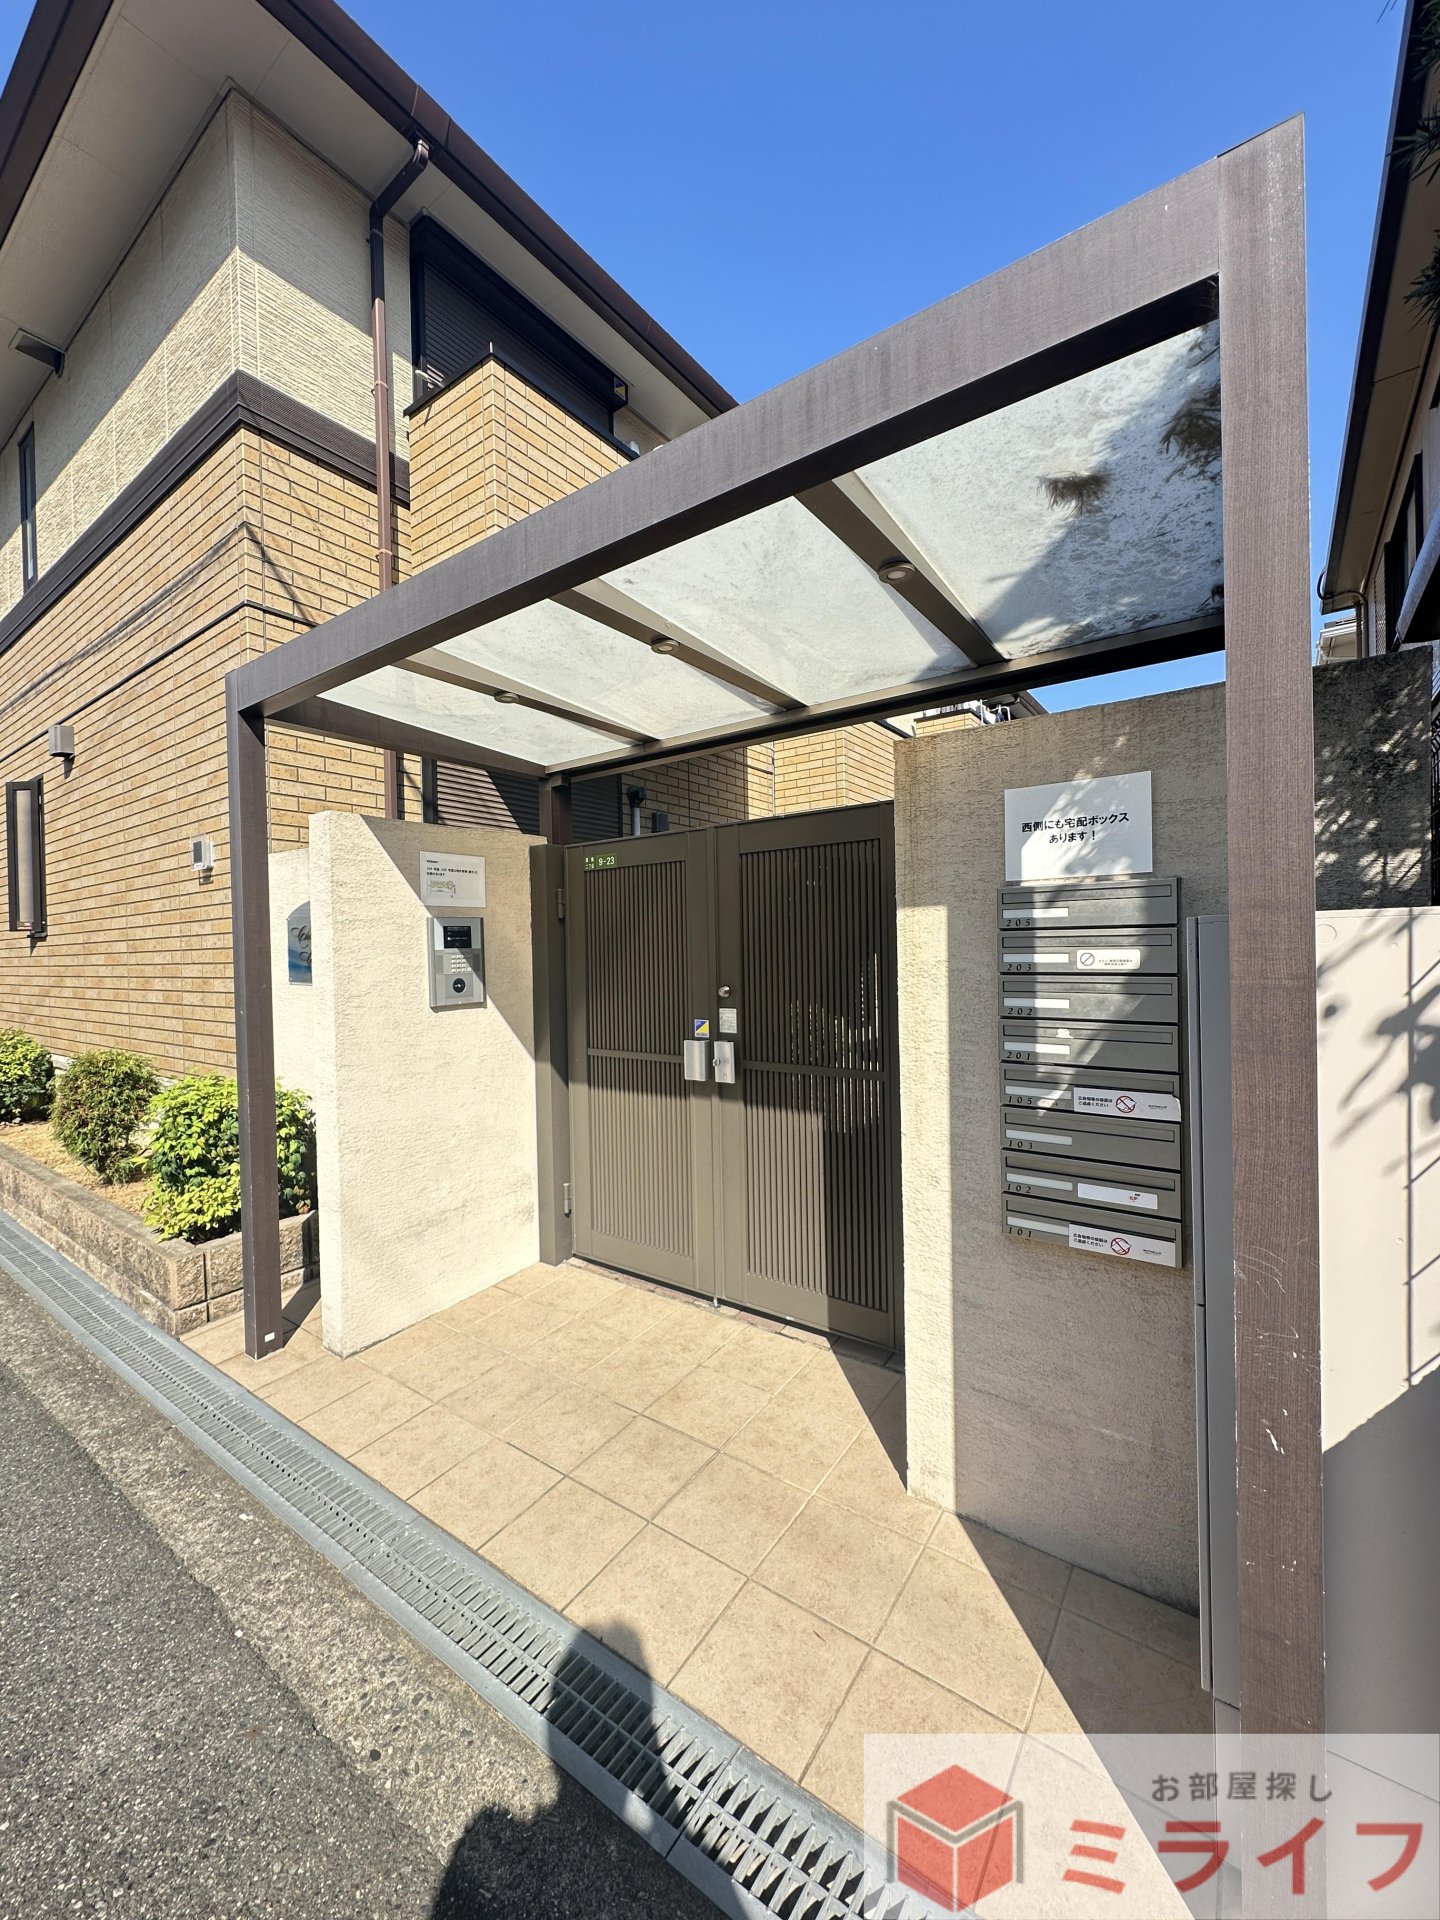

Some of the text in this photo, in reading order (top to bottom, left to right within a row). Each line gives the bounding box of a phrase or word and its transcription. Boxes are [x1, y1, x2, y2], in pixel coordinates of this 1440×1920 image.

[1022, 812, 1130, 833] 西側にも宅配ボックス
[598, 856, 615, 866] 9-23
[1006, 918, 1031, 927] 205
[1007, 963, 1032, 971] 203
[1007, 1007, 1033, 1016] 202
[1006, 1051, 1031, 1060] 201
[1008, 1096, 1033, 1105] 105
[1008, 1140, 1033, 1150] 103
[1007, 1183, 1032, 1194] 102
[1008, 1227, 1033, 1238] 101
